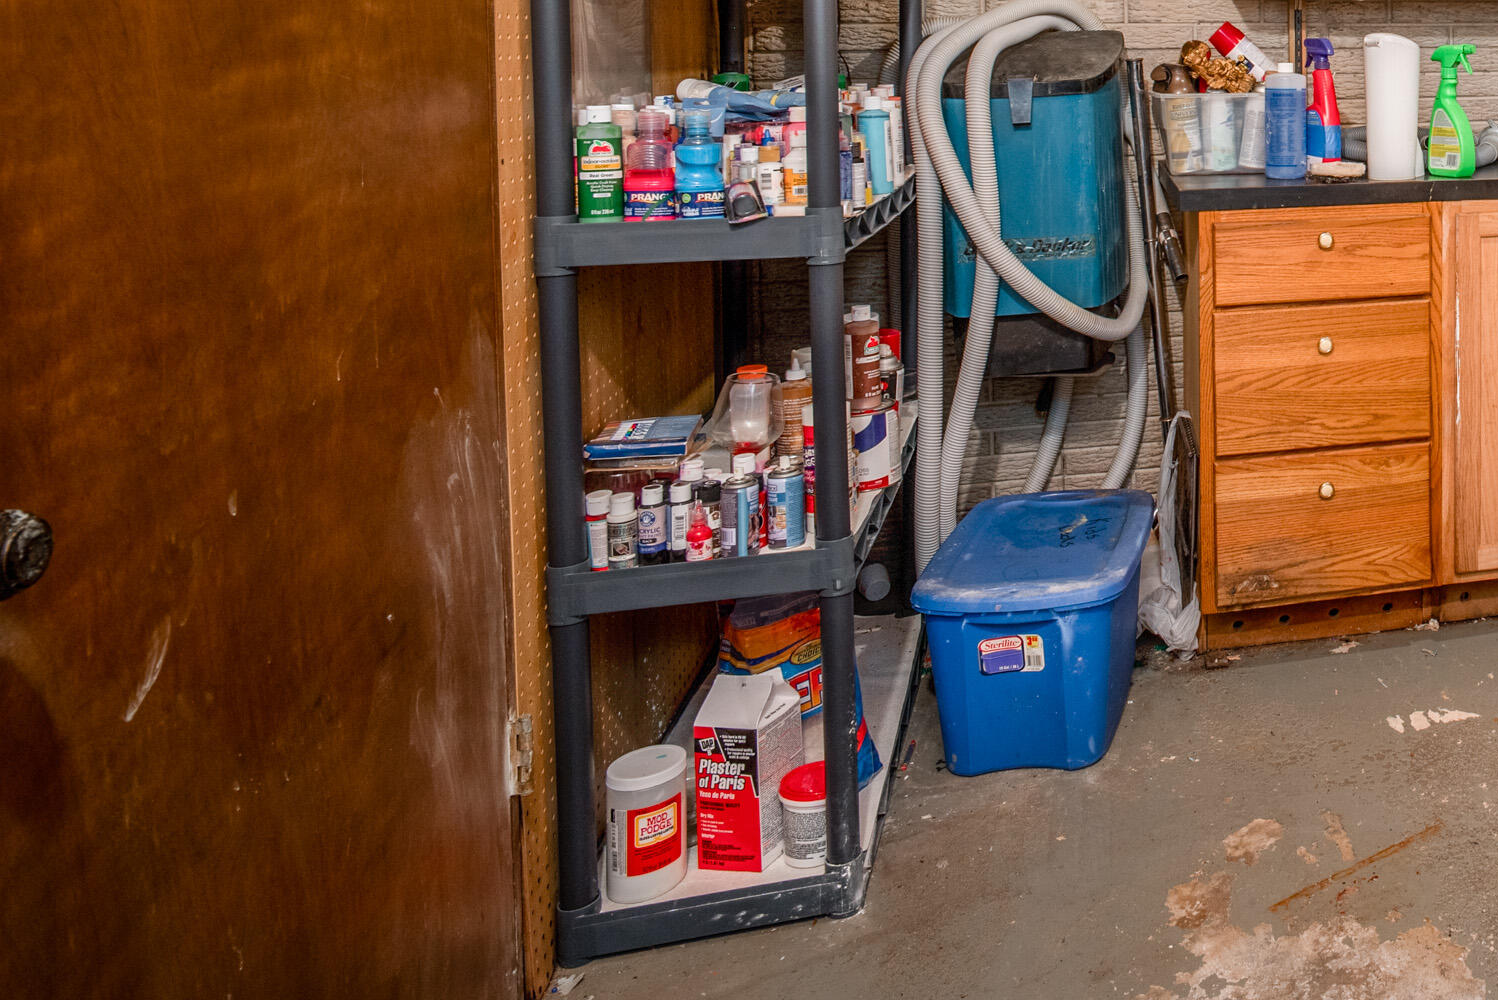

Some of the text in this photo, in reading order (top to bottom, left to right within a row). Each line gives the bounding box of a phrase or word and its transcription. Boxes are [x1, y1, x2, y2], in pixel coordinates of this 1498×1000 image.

[697, 192, 725, 201] PRAN
[984, 639, 1017, 650] Sterilite
[698, 758, 746, 776] Plaster
[698, 775, 746, 791] of Paris
[646, 811, 668, 826] MOD
[640, 818, 672, 837] PODGE
